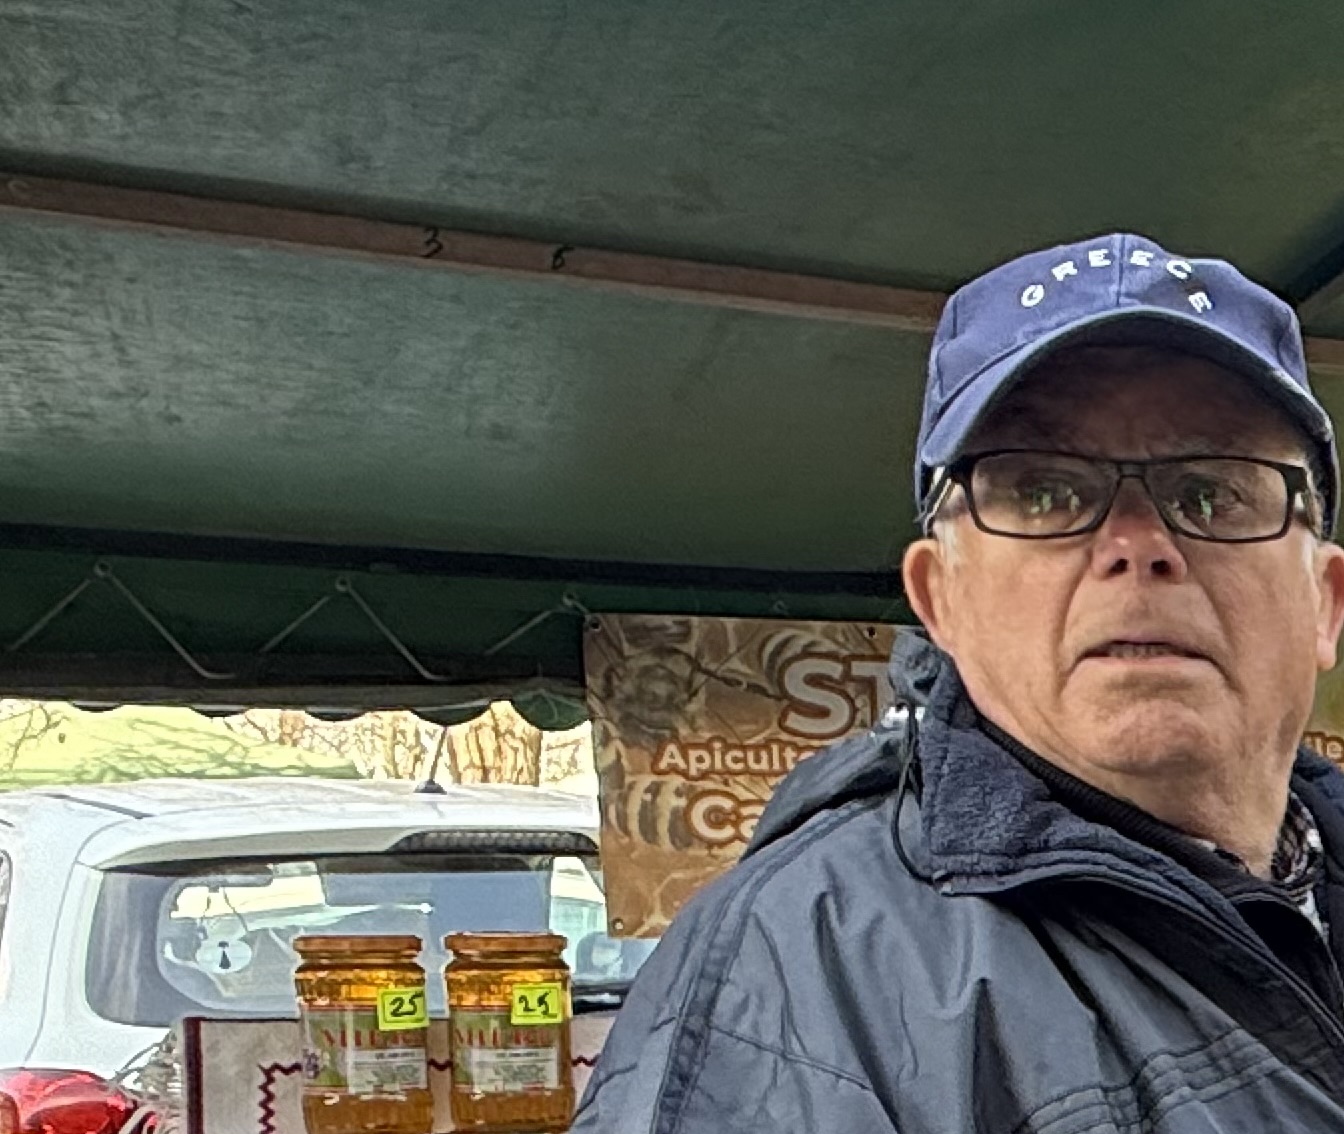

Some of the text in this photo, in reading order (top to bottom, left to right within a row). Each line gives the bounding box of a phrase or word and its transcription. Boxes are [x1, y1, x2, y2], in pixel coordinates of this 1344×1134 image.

[1020, 248, 1213, 314] GREECE
[781, 655, 894, 736] ST
[657, 743, 813, 776] Apicult
[389, 991, 424, 1018] 25
[518, 991, 558, 1019] 25
